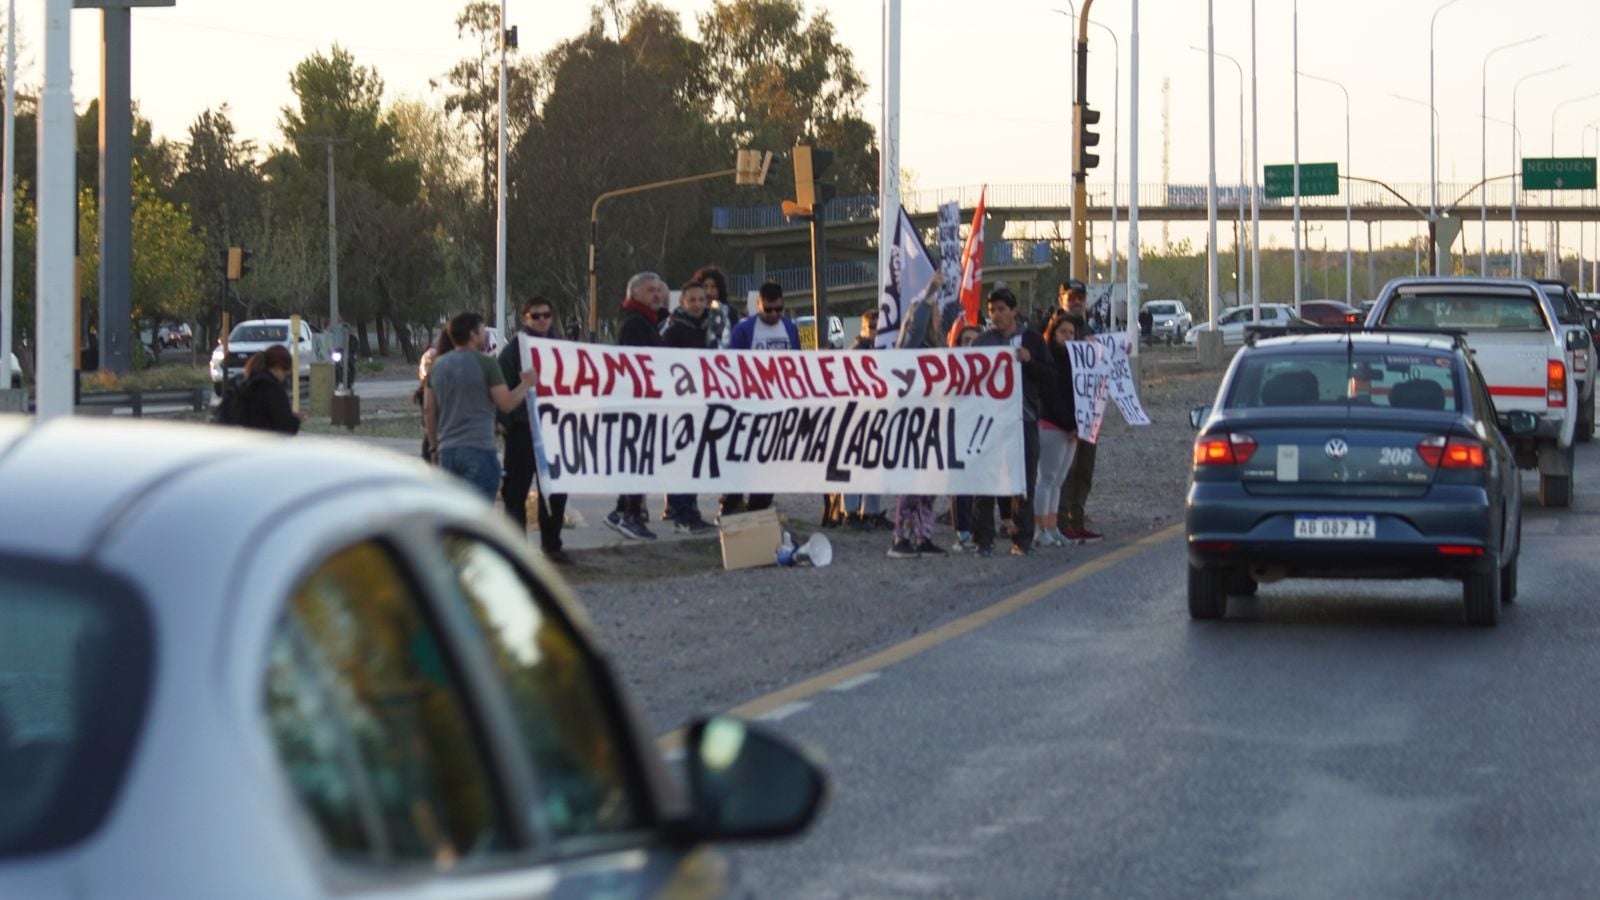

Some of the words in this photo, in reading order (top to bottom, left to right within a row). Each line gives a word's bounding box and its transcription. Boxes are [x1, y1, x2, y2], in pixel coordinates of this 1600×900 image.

[1527, 161, 1592, 173] NEUQUEN
[1072, 343, 1096, 369] NO
[531, 347, 662, 399] LLAME
[670, 363, 696, 396] a
[699, 354, 888, 400] ASAMBLEAS
[891, 369, 916, 397] y
[917, 352, 1014, 400] PARO
[538, 404, 657, 479] CONTRA
[692, 404, 836, 479] REFORMA
[1379, 446, 1412, 466] 206
[1299, 521, 1316, 535] AB
[1322, 521, 1348, 535] 087
